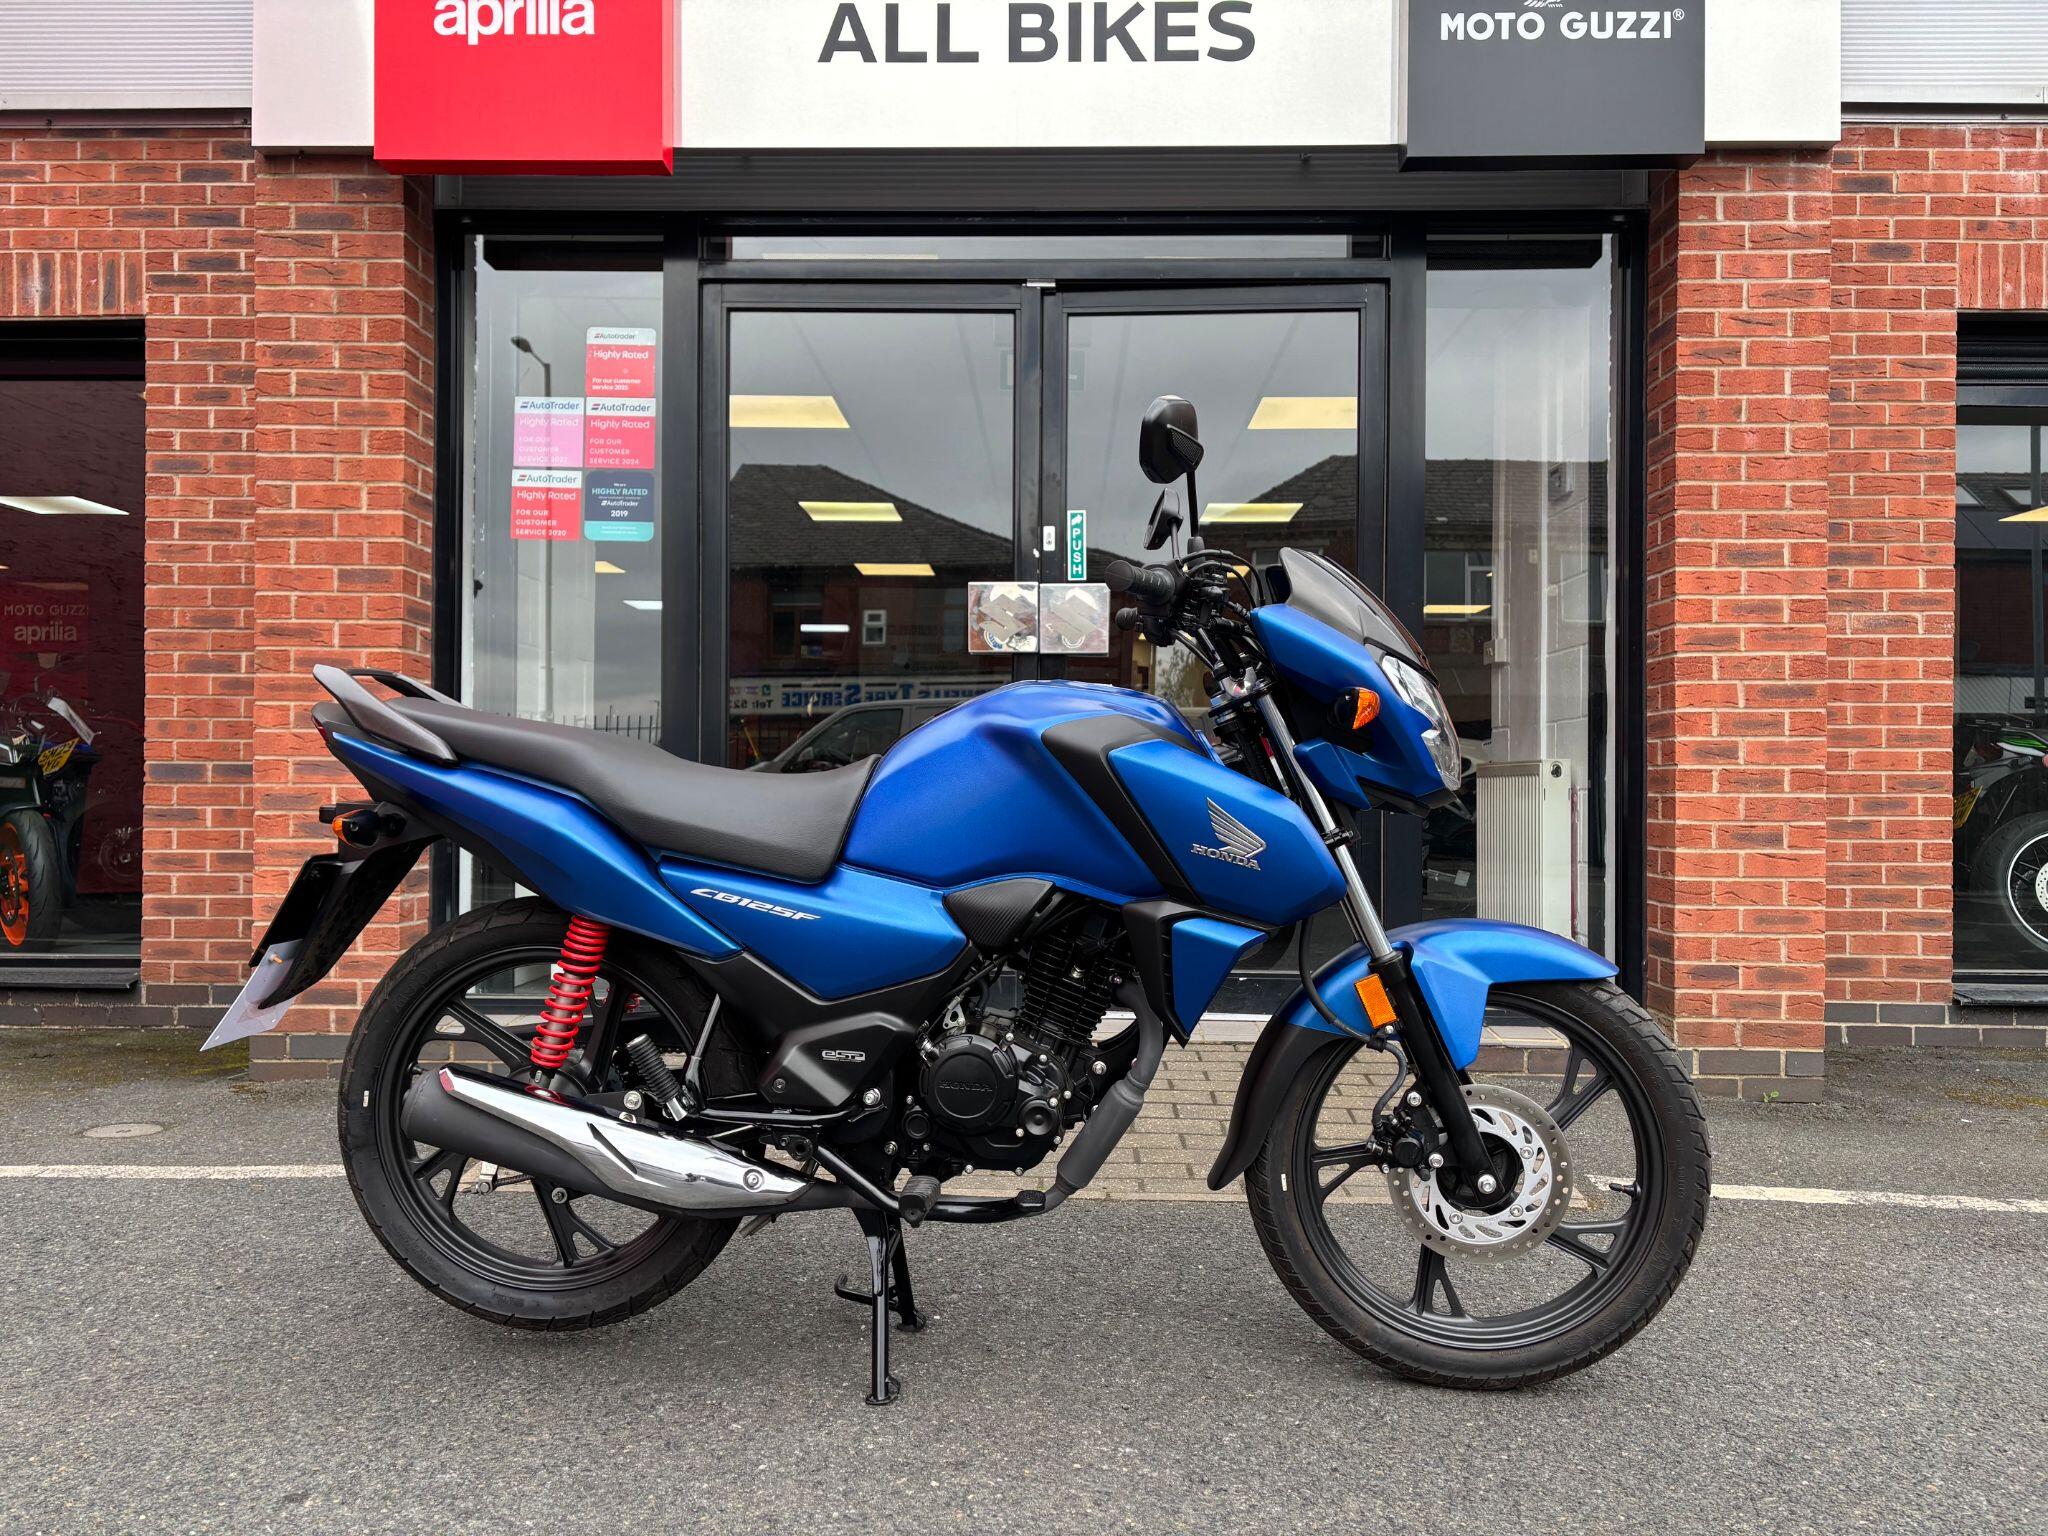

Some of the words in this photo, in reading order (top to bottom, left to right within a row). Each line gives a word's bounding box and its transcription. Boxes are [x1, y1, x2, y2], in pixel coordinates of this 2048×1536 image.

[433, 0, 595, 45] aprilia
[1440, 12, 1545, 41] MOTO
[818, 2, 978, 63] ALL
[1008, 1, 1255, 63] BIKES
[592, 350, 621, 360] Highly
[621, 350, 649, 359] Rated
[528, 401, 580, 411] AutoTrader
[600, 403, 651, 412] AutoTrader
[519, 418, 548, 429] Highly
[551, 418, 579, 427] Rated
[590, 420, 619, 430] Highly
[621, 420, 650, 429] Rated
[526, 475, 577, 484] AutoTrader
[516, 491, 546, 501] Highly
[548, 491, 576, 500] Rated
[591, 487, 622, 495] HIGHLY
[622, 488, 649, 496] RATED
[515, 528, 547, 536] SERVICE
[1071, 528, 1083, 575] PUSH
[4, 604, 44, 616] MOTO
[14, 620, 77, 645] aprilia
[1190, 843, 1261, 871] HONDA
[690, 888, 821, 920] CB125F
[936, 1080, 993, 1092] HONDA
